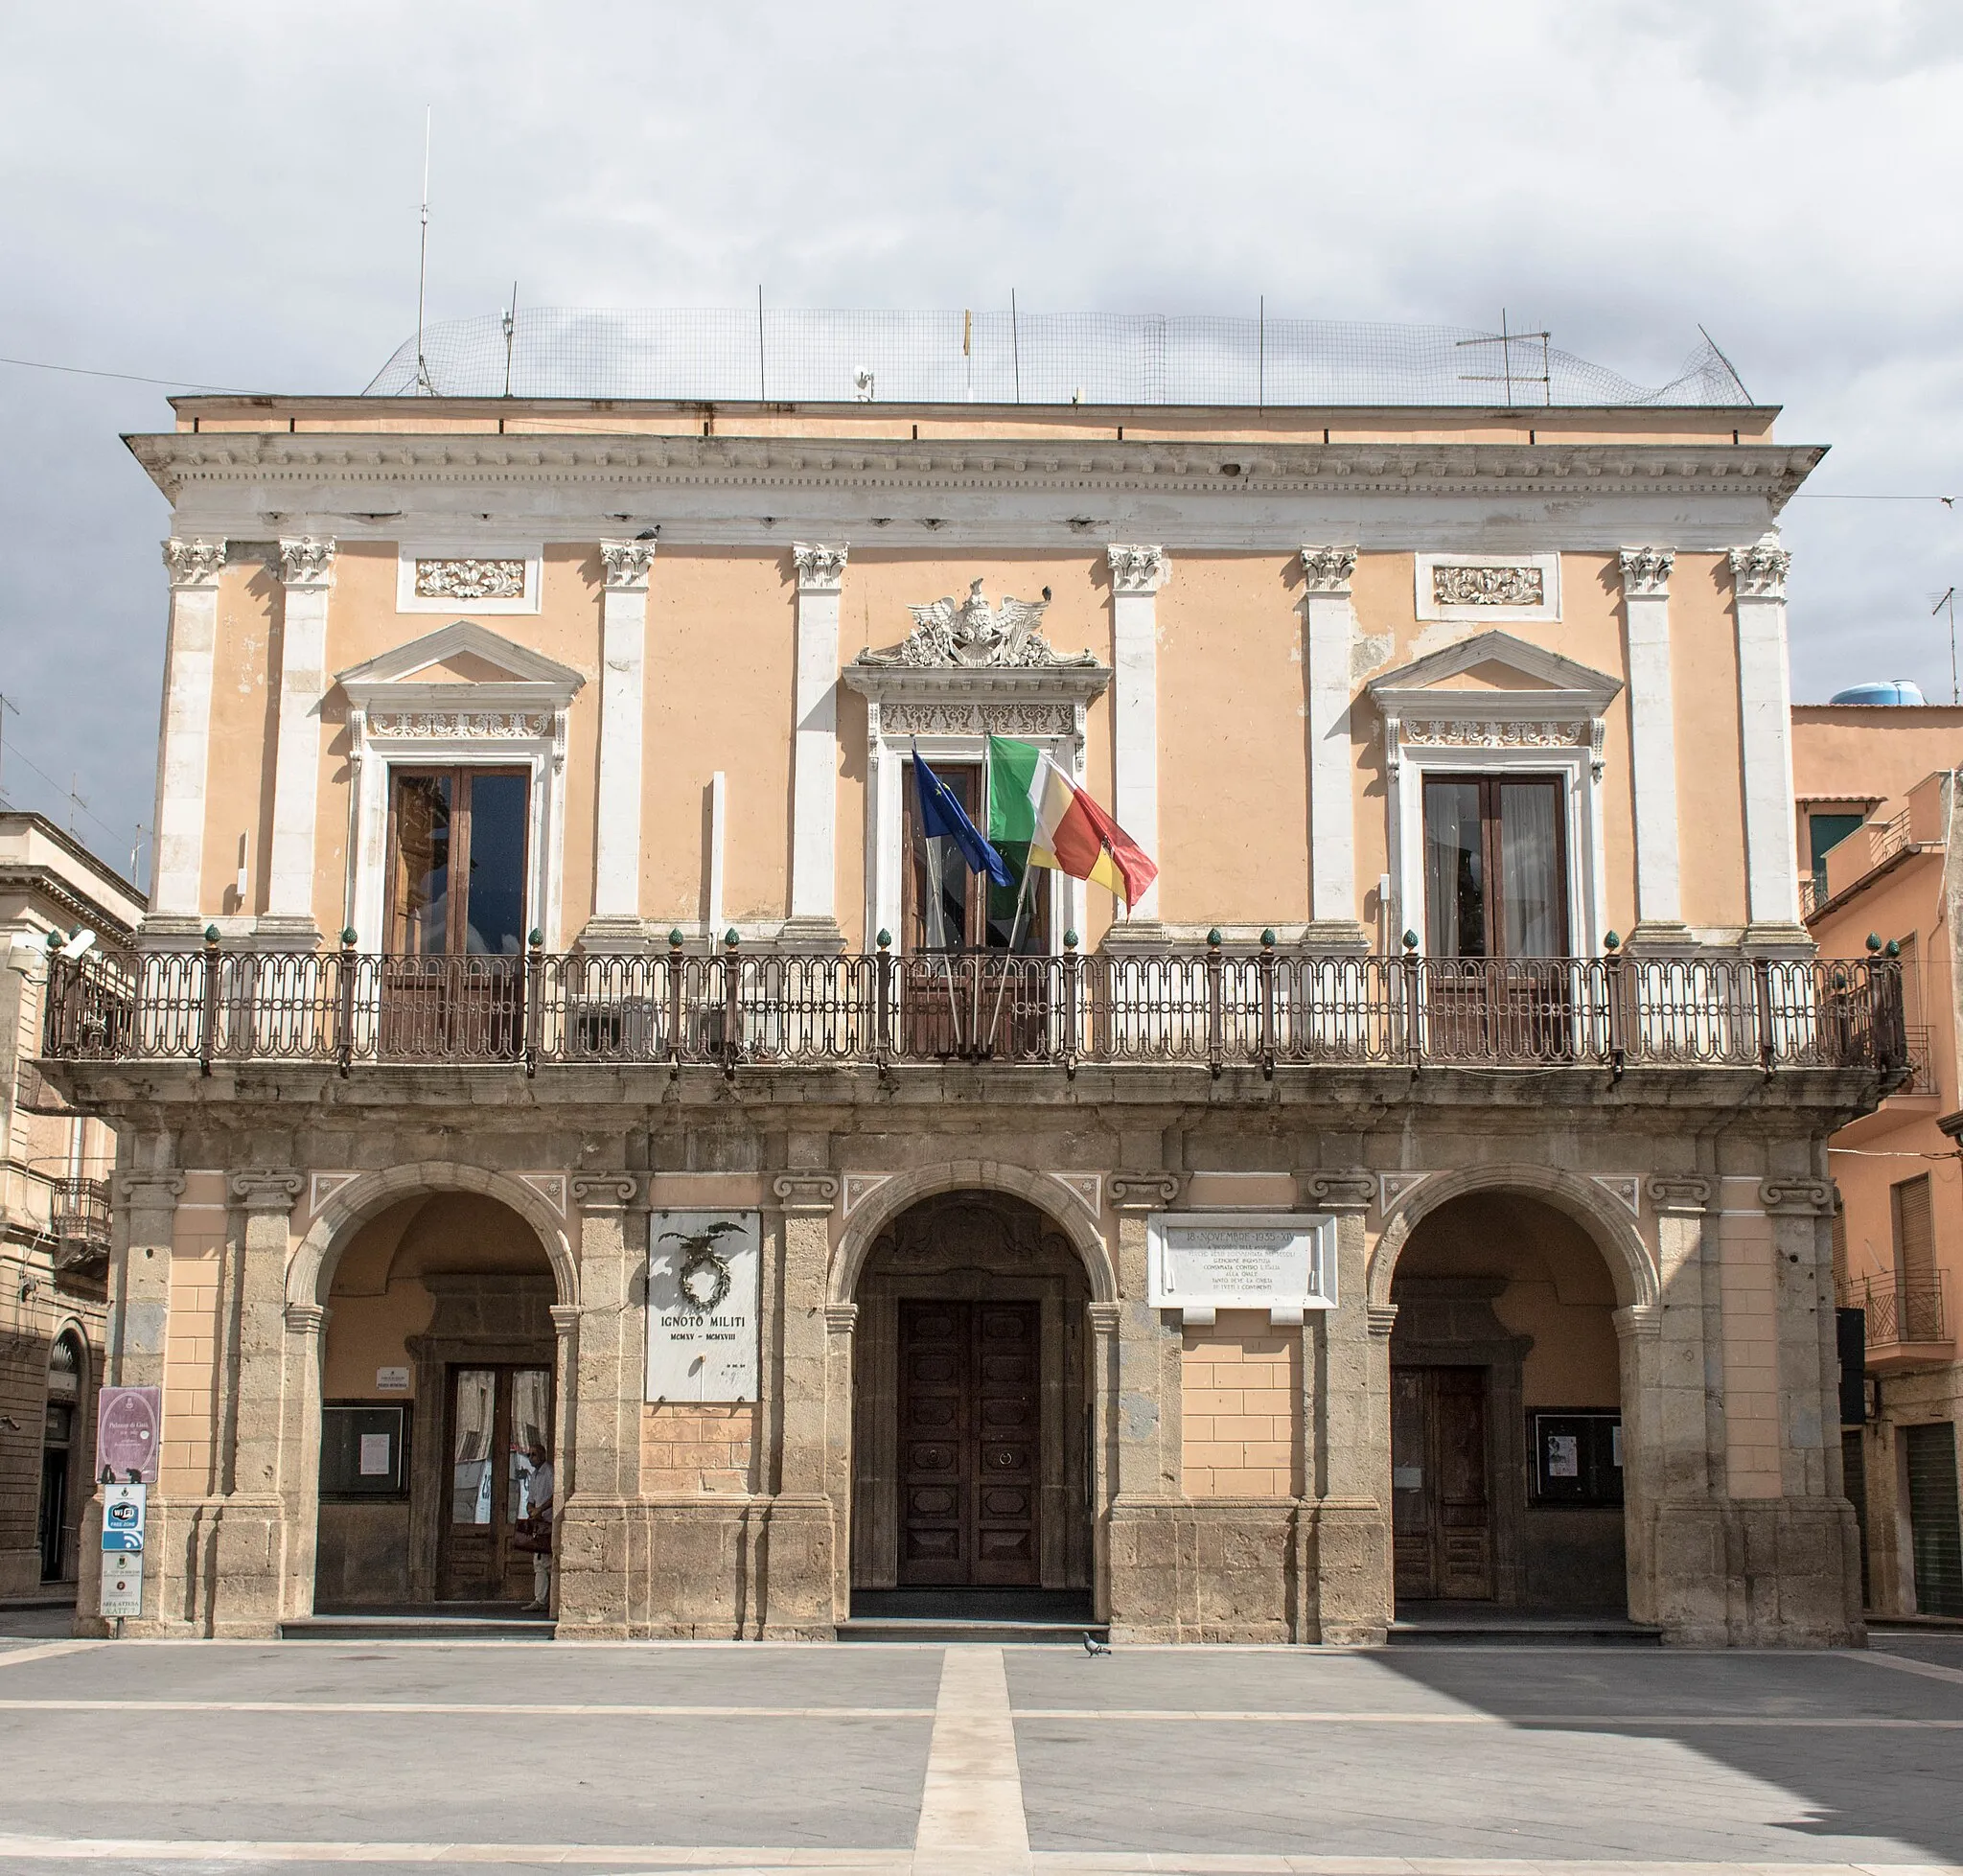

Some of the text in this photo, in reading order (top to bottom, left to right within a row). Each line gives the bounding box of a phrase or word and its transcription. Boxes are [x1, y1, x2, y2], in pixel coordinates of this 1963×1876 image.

[1187, 1232, 1196, 1241] 18
[1200, 1232, 1250, 1243] NOVEMBRE
[661, 1316, 745, 1328] IGNOTO MILITI
